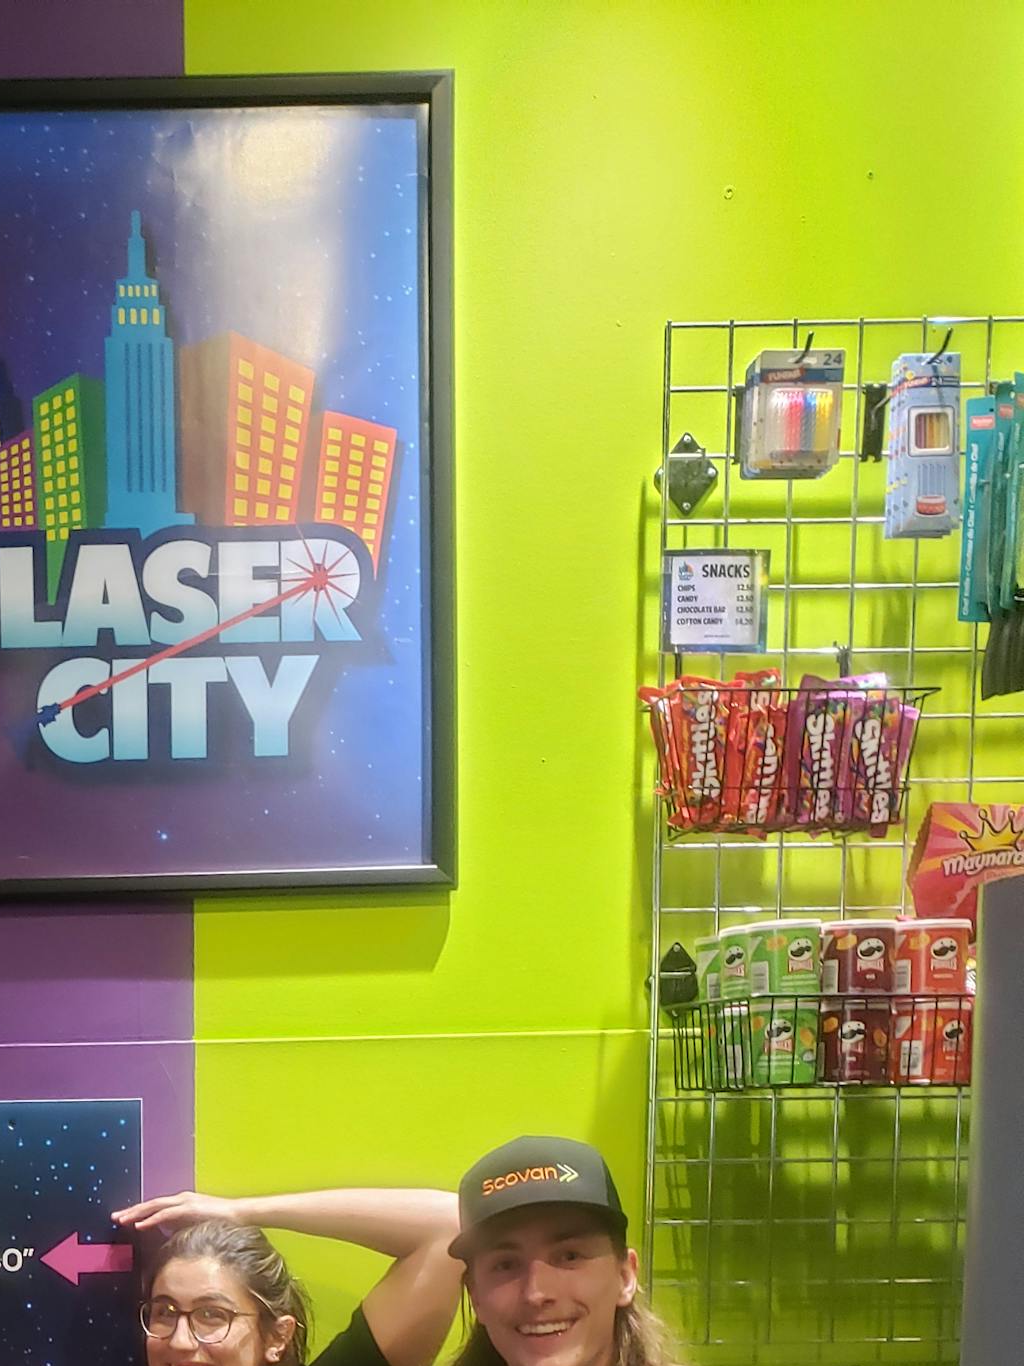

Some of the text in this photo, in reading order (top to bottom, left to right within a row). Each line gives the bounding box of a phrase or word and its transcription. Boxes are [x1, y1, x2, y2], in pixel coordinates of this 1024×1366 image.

[823, 353, 843, 366] 24
[702, 563, 750, 579] SNACKS
[677, 584, 696, 592] CHIPS
[677, 595, 698, 603] CANDY
[676, 606, 712, 614] CHOCOLATE
[676, 617, 702, 625] COTTON
[703, 617, 723, 625] CANDY
[36, 654, 320, 764] CITY
[806, 712, 836, 824] Skittles
[855, 718, 893, 824] Skittles
